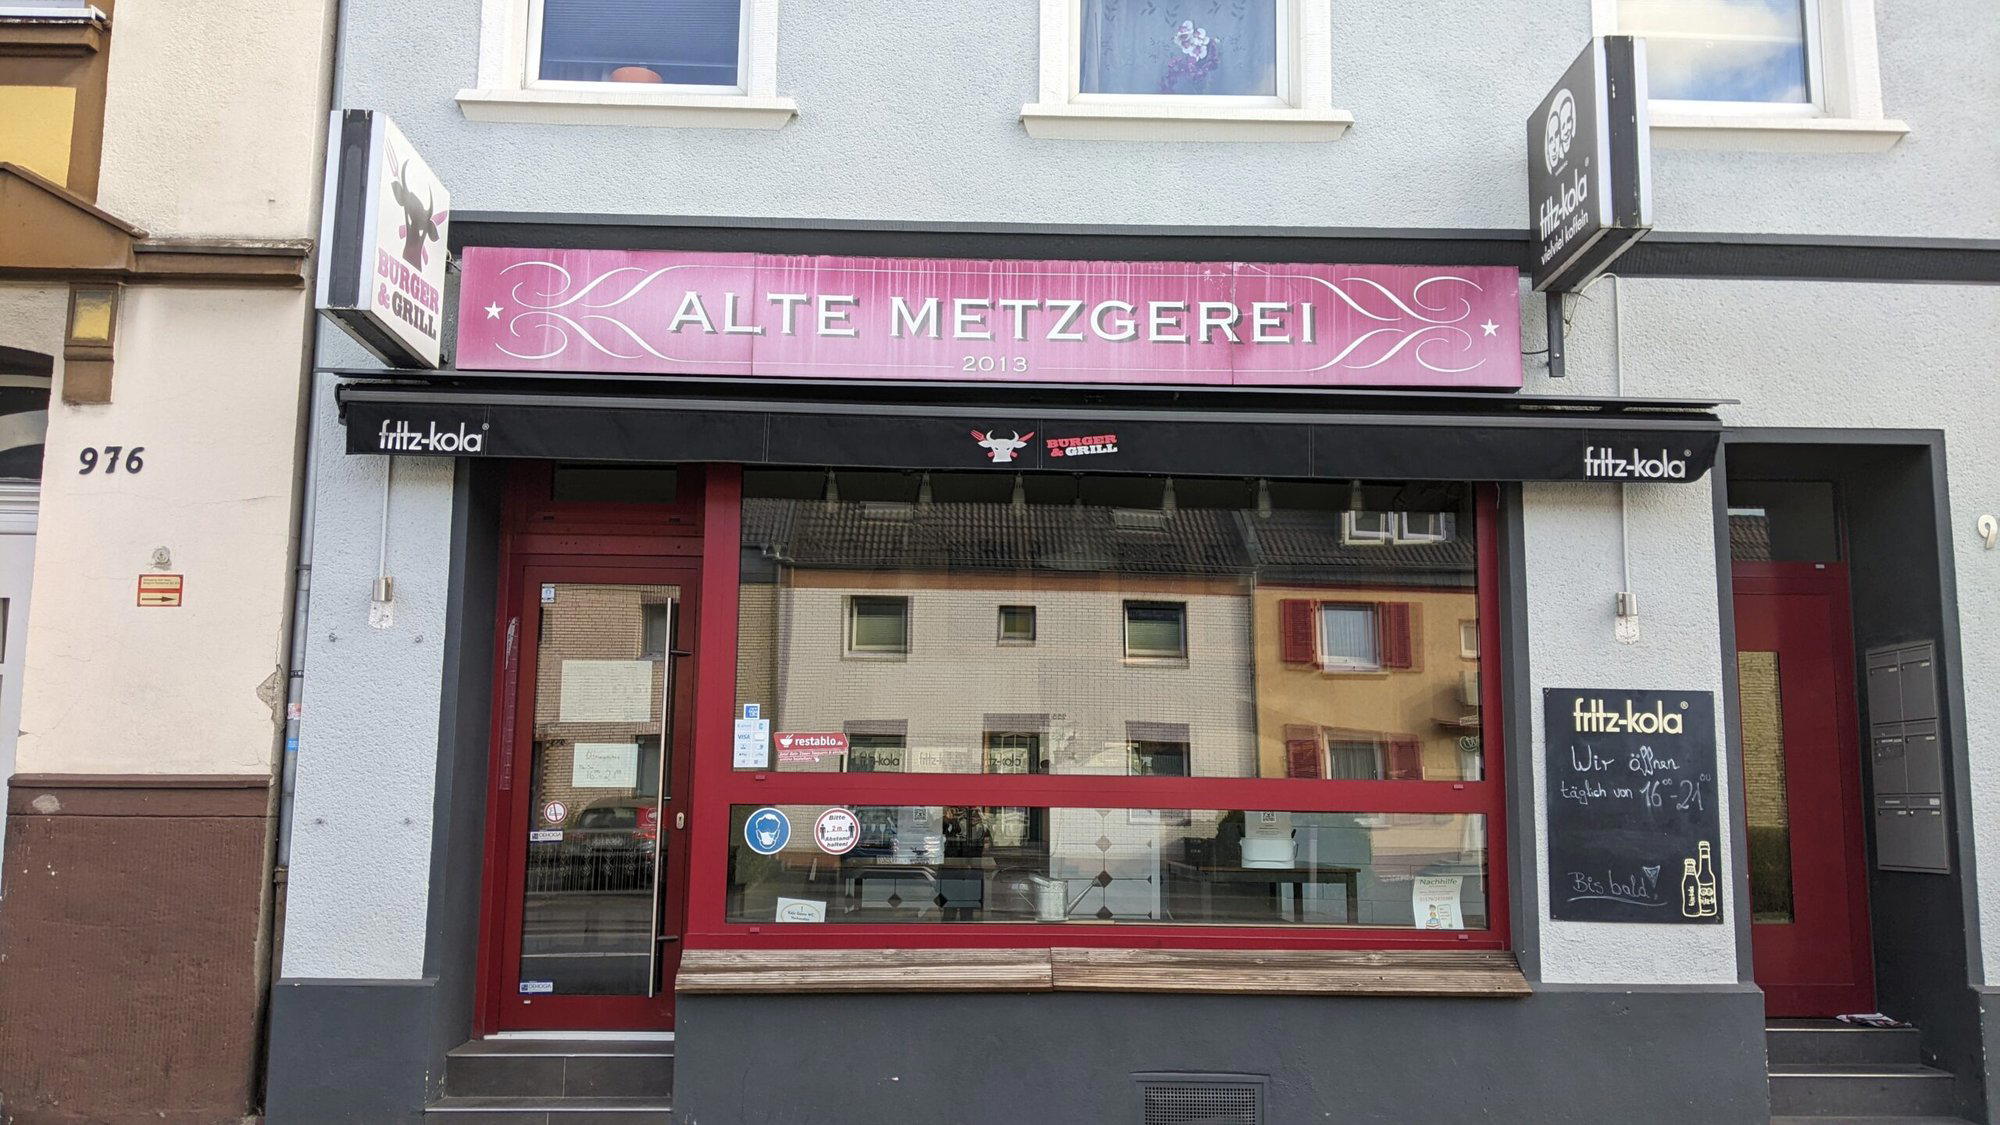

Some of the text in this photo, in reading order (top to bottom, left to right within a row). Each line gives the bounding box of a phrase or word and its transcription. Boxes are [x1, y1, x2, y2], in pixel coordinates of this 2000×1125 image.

[1539, 168, 1588, 242] fritz-kola
[1564, 208, 1589, 244] koffein
[377, 247, 440, 315] BURGER
[377, 282, 438, 341] & GRILL
[666, 290, 1316, 344] ALTE METZGEREI
[962, 355, 1029, 373] 2013
[378, 419, 482, 452] fritz-kola
[1046, 434, 1118, 449] BURGER
[1050, 443, 1118, 458] & GRILL
[78, 446, 145, 475] 976
[1584, 446, 1686, 479] fritz-kola
[1977, 514, 1999, 550] 9
[1573, 698, 1683, 734] fritz-kola
[1571, 744, 1680, 777] Wir öffnen
[1560, 779, 1607, 805] täglich
[1613, 788, 1634, 799] von
[1419, 877, 1458, 885] Nachhilfe
[1568, 872, 1604, 895] Bis
